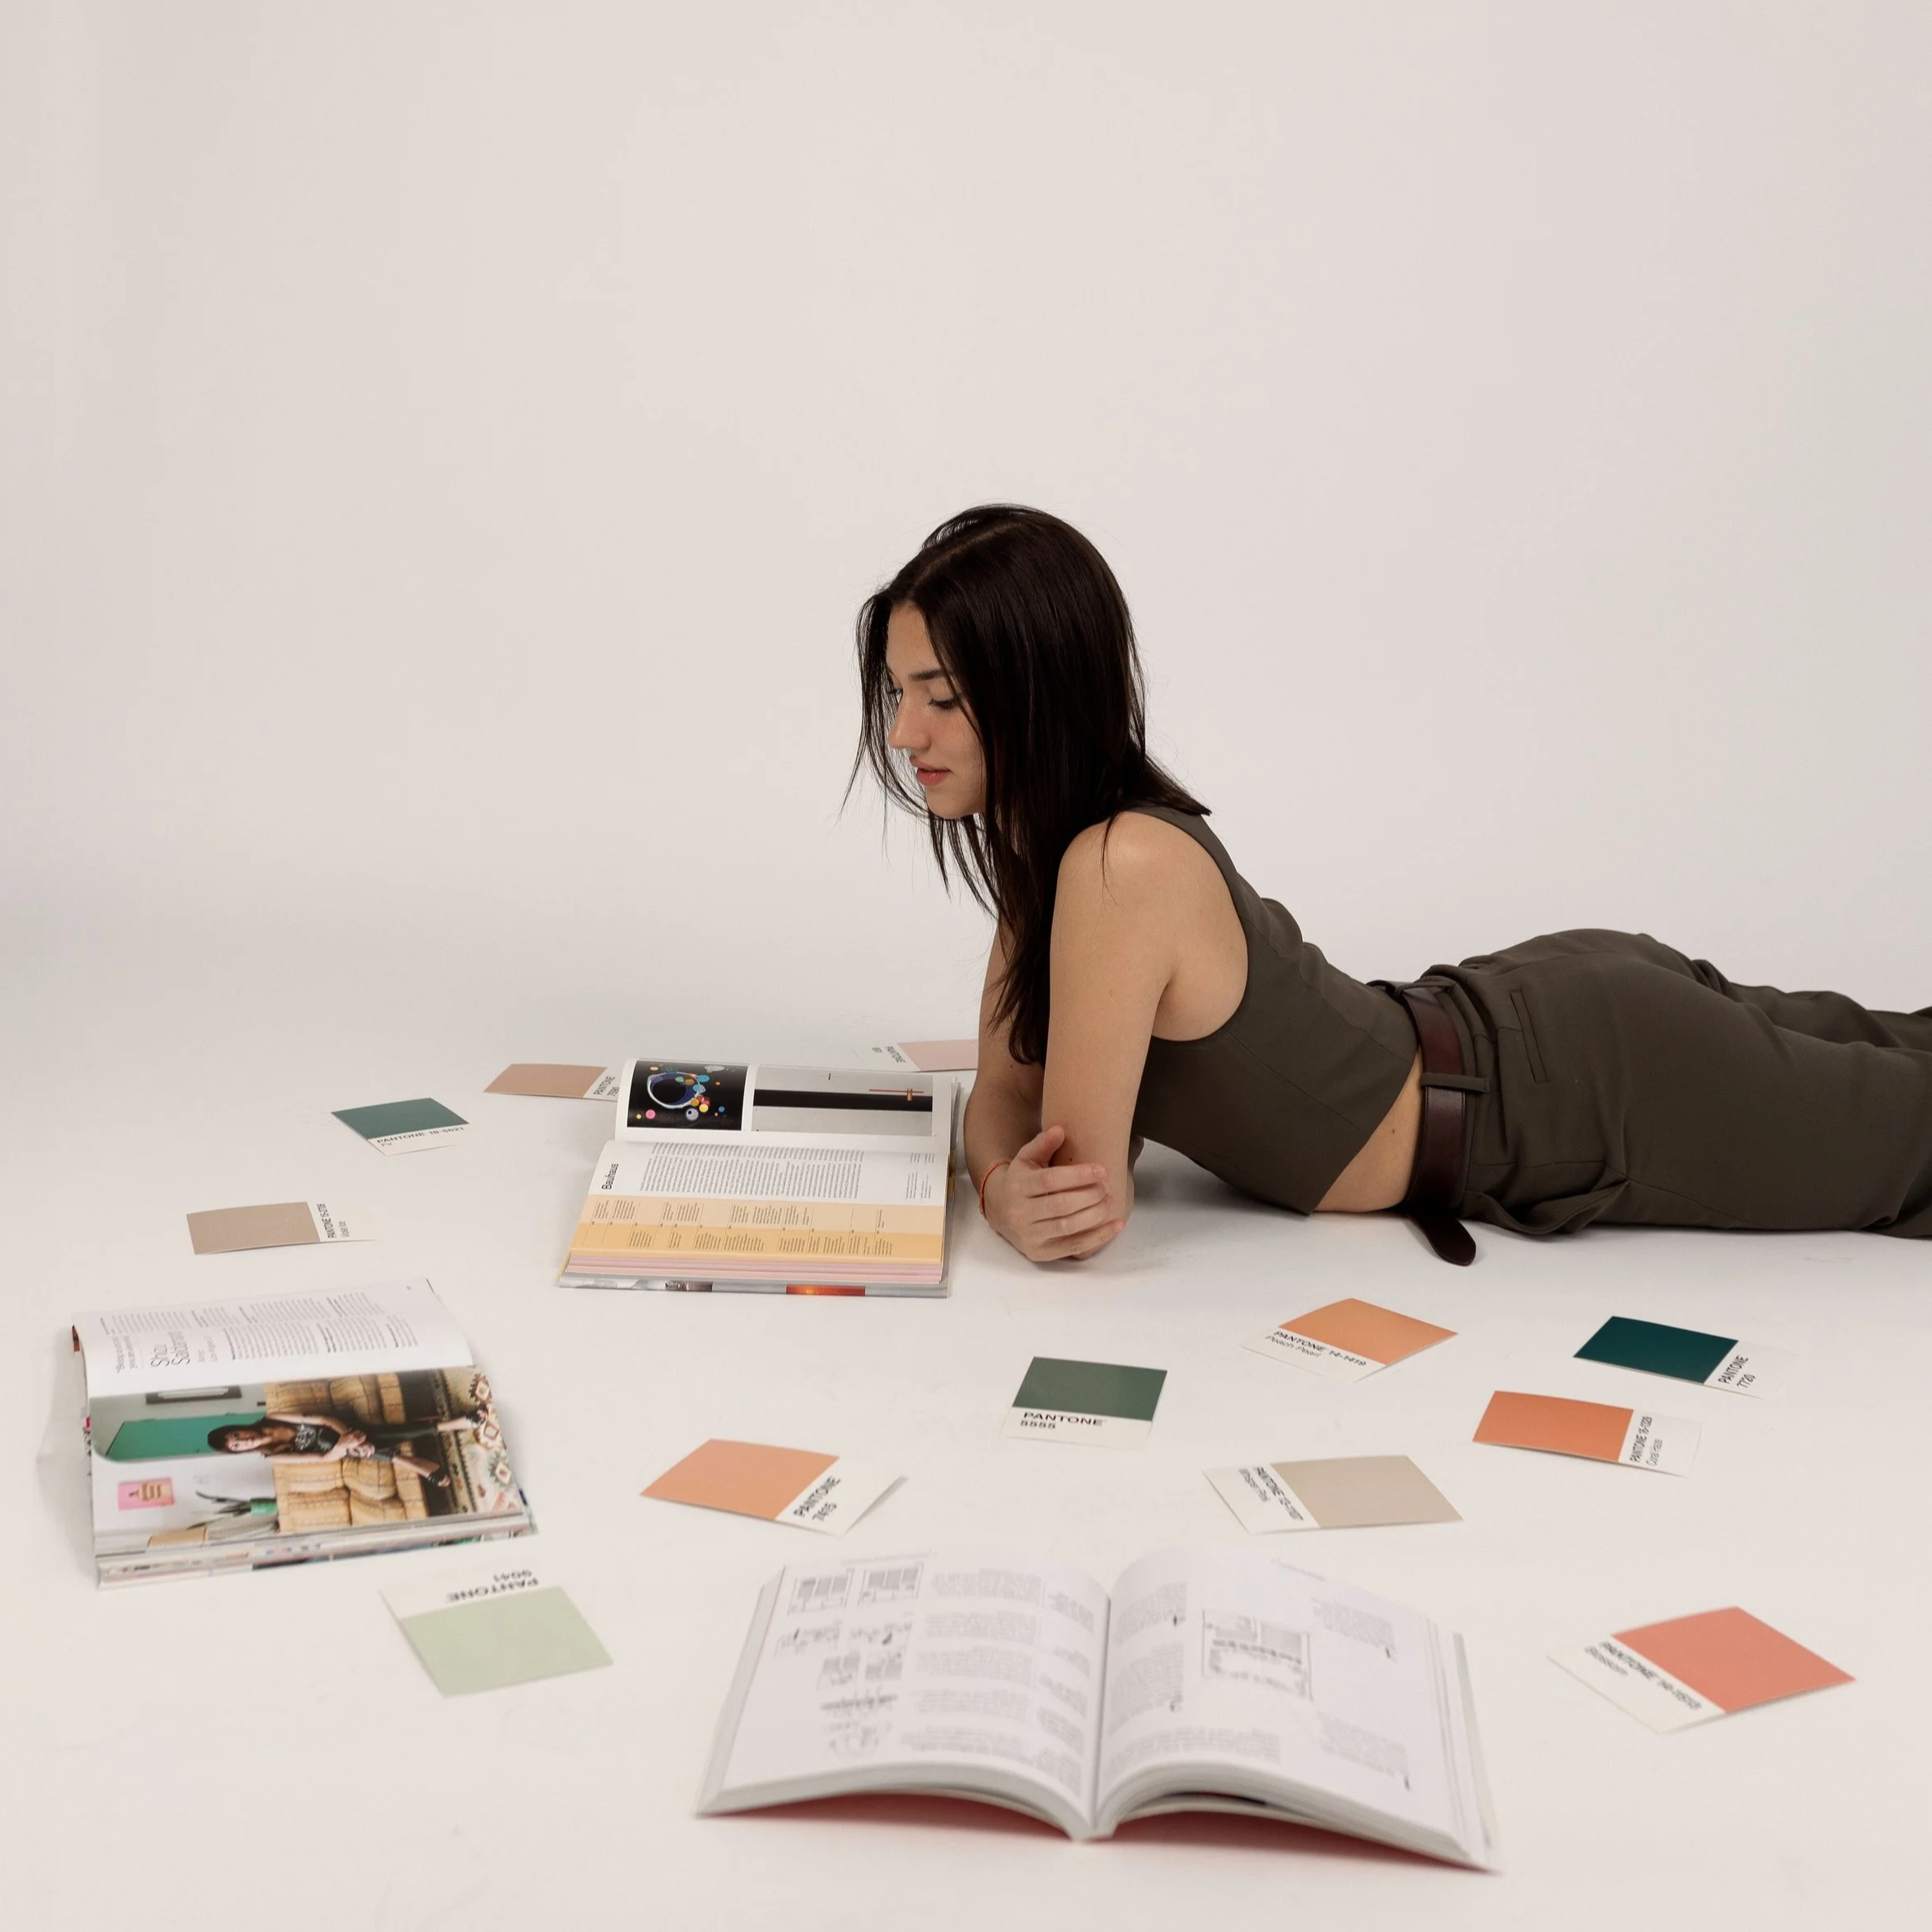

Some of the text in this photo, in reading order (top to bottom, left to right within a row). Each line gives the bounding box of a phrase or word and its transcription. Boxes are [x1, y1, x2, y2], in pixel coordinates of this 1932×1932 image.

[593, 1076, 615, 1095] PANTONE
[377, 1132, 426, 1144] PANTONE
[601, 1163, 618, 1189] Bauhaus
[1265, 1335, 1294, 1348] Peach
[1274, 1331, 1327, 1351] PANTONE
[1718, 1355, 1749, 1384] PANTONE
[1736, 1374, 1756, 1389] 7720
[1020, 1420, 1056, 1429] 5555
[1024, 1412, 1103, 1426] PANTONE
[1630, 1435, 1647, 1463] PANTONE
[1253, 1466, 1279, 1497] PANTONE
[793, 1476, 841, 1517] PANTONE
[446, 1577, 538, 1603] PANTONE
[1599, 1641, 1659, 1681] PANTONE
